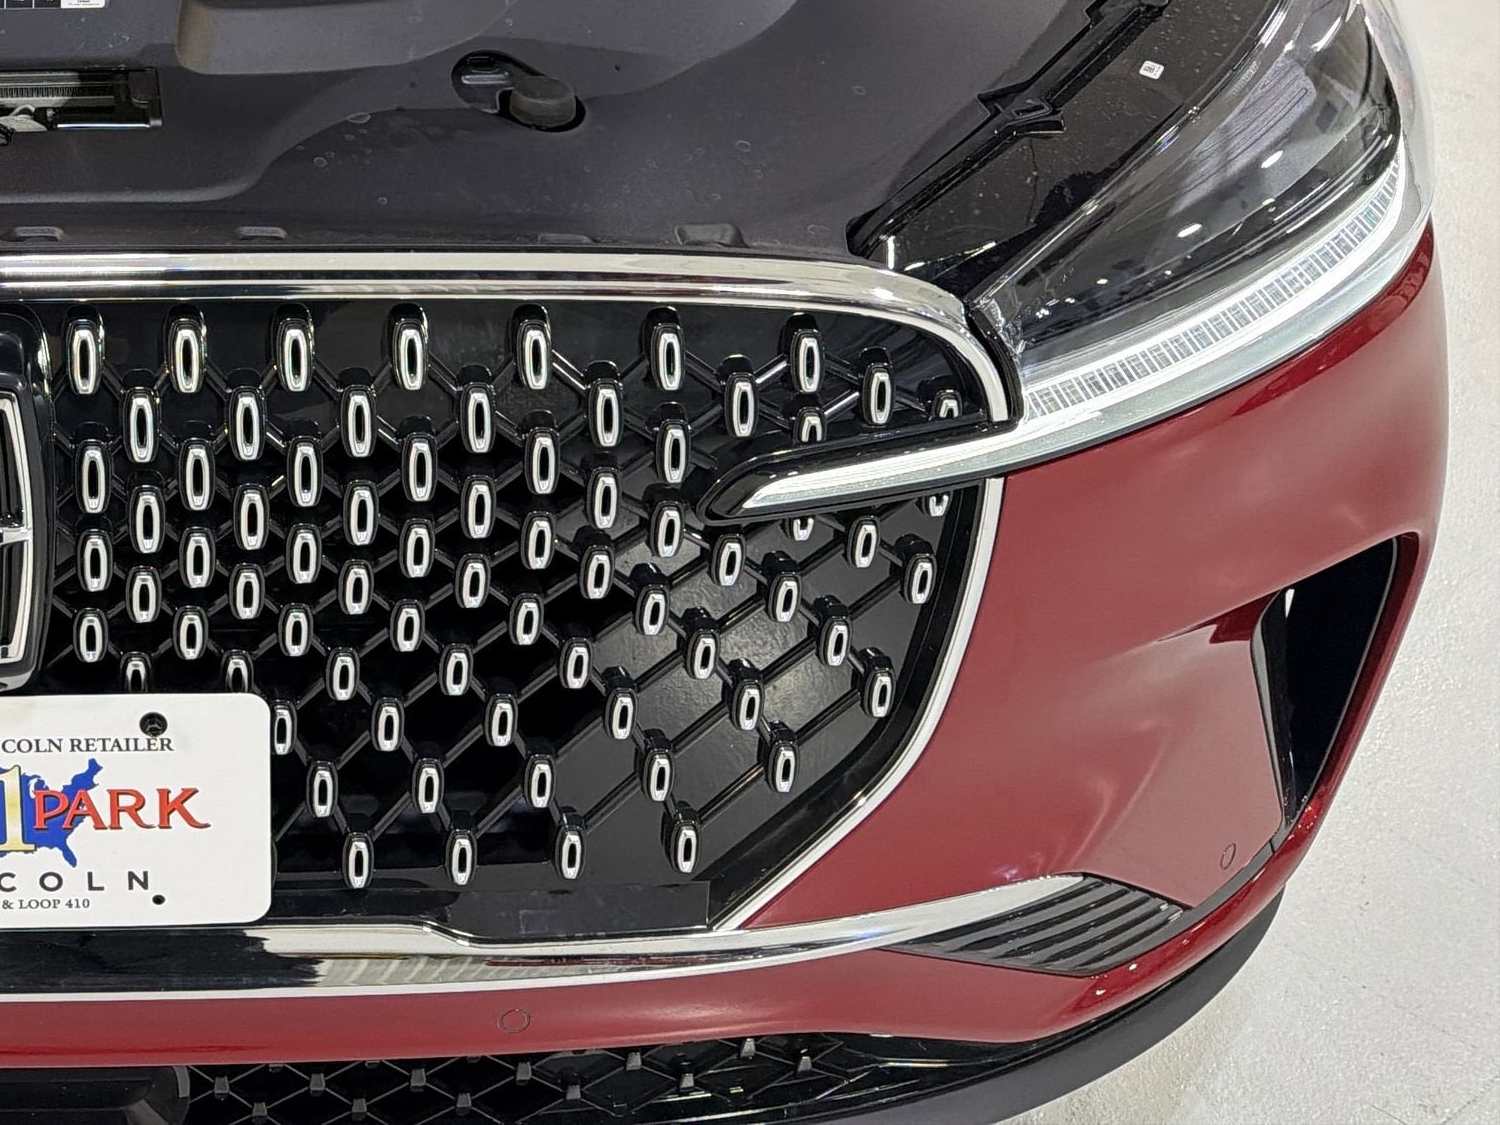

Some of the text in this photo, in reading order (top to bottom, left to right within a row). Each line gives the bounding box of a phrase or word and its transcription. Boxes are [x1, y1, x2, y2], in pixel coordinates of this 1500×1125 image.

[69, 736, 175, 753] RETAILER
[33, 787, 212, 831] PARK
[1, 899, 15, 910] &
[17, 898, 62, 911] LOOP
[65, 898, 91, 909] 410
